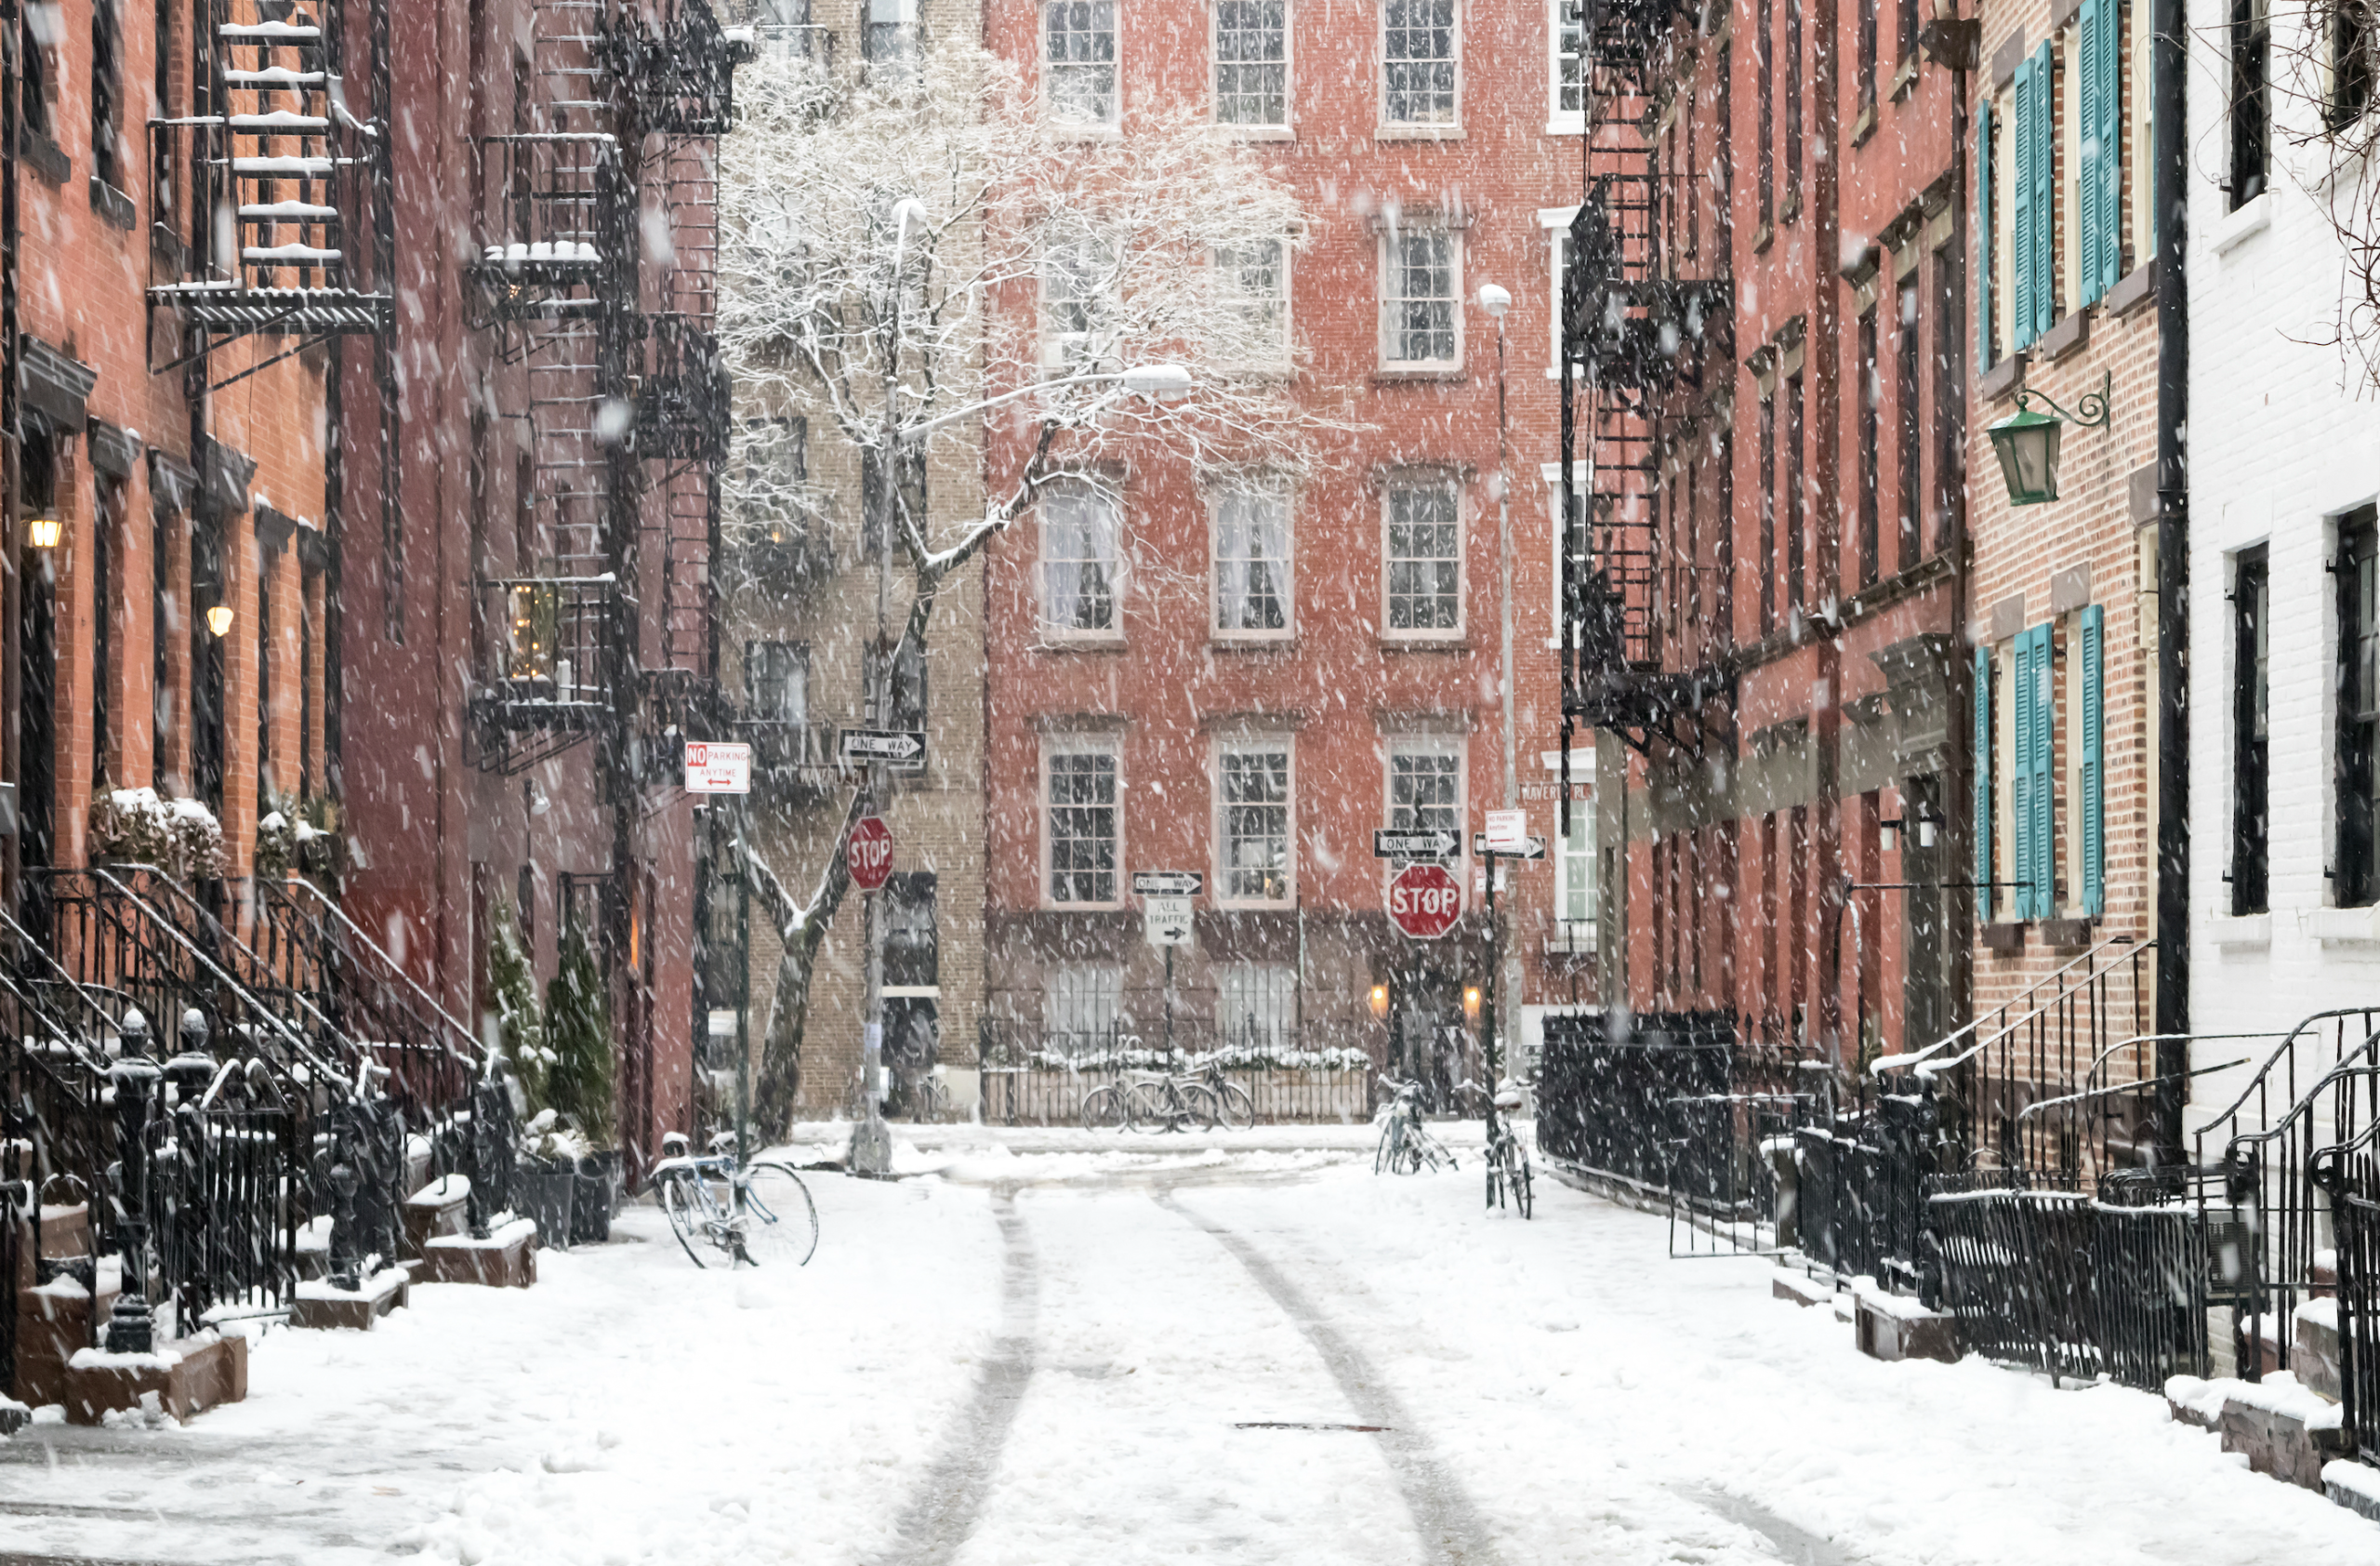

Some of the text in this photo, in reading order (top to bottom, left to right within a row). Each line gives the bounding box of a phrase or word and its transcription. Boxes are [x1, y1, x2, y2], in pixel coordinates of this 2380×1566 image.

[852, 738, 912, 751] ONE WAY
[689, 748, 747, 764] NO PARKING
[1522, 785, 1562, 800] WAVERL
[1386, 839, 1447, 849] ONE WAY
[850, 839, 891, 868] STOP
[1138, 879, 1160, 888] ONE
[1158, 902, 1180, 911] ALL
[1393, 887, 1457, 914] STOP
[1150, 914, 1189, 924] TRAFFIC
